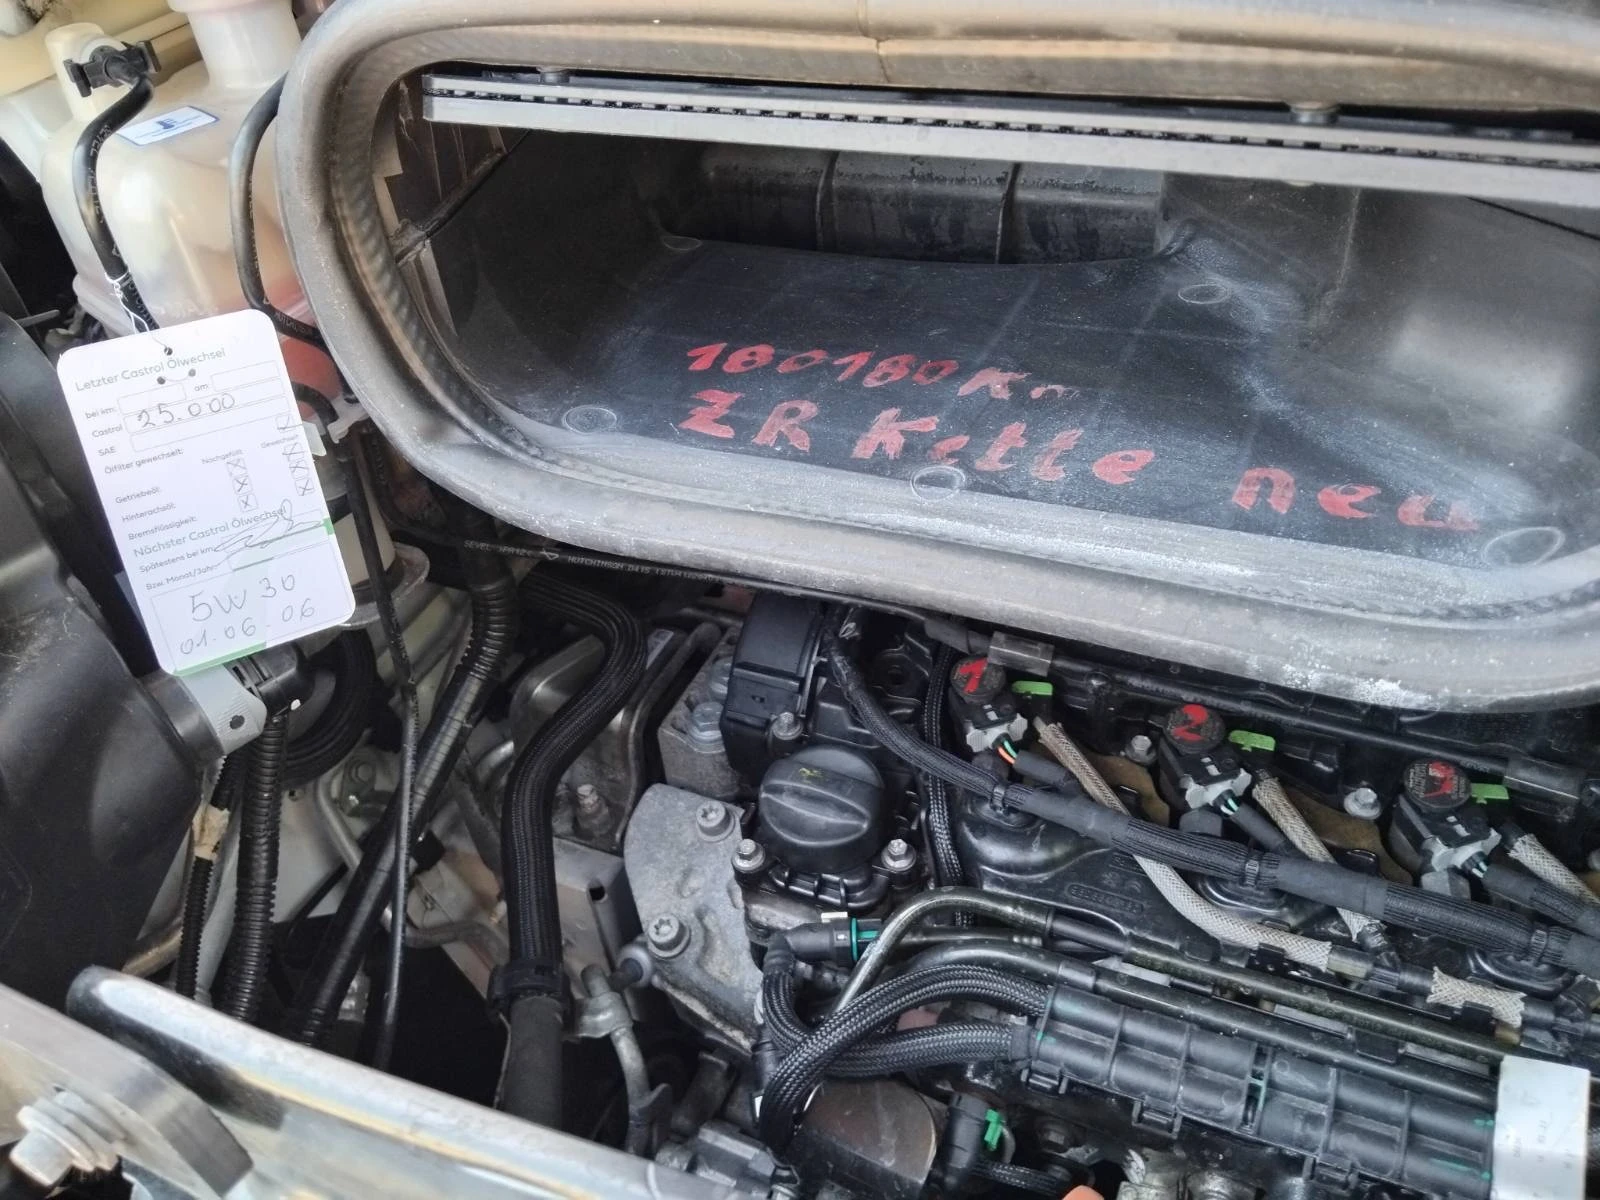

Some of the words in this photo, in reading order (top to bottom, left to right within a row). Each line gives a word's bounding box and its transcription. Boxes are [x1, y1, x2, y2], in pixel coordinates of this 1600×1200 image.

[75, 374, 119, 393] Letzter
[120, 362, 165, 382] Castrol
[166, 347, 226, 370] Ölwechsel
[687, 342, 960, 388] 180180
[91, 423, 124, 438] Castrol
[104, 458, 134, 475] Ölfilter
[133, 535, 187, 558] Nächster
[188, 522, 230, 542] Castrol
[230, 505, 287, 529] Ölwechsel
[138, 554, 186, 574] Spätestens
[1171, 703, 1209, 742] 2
